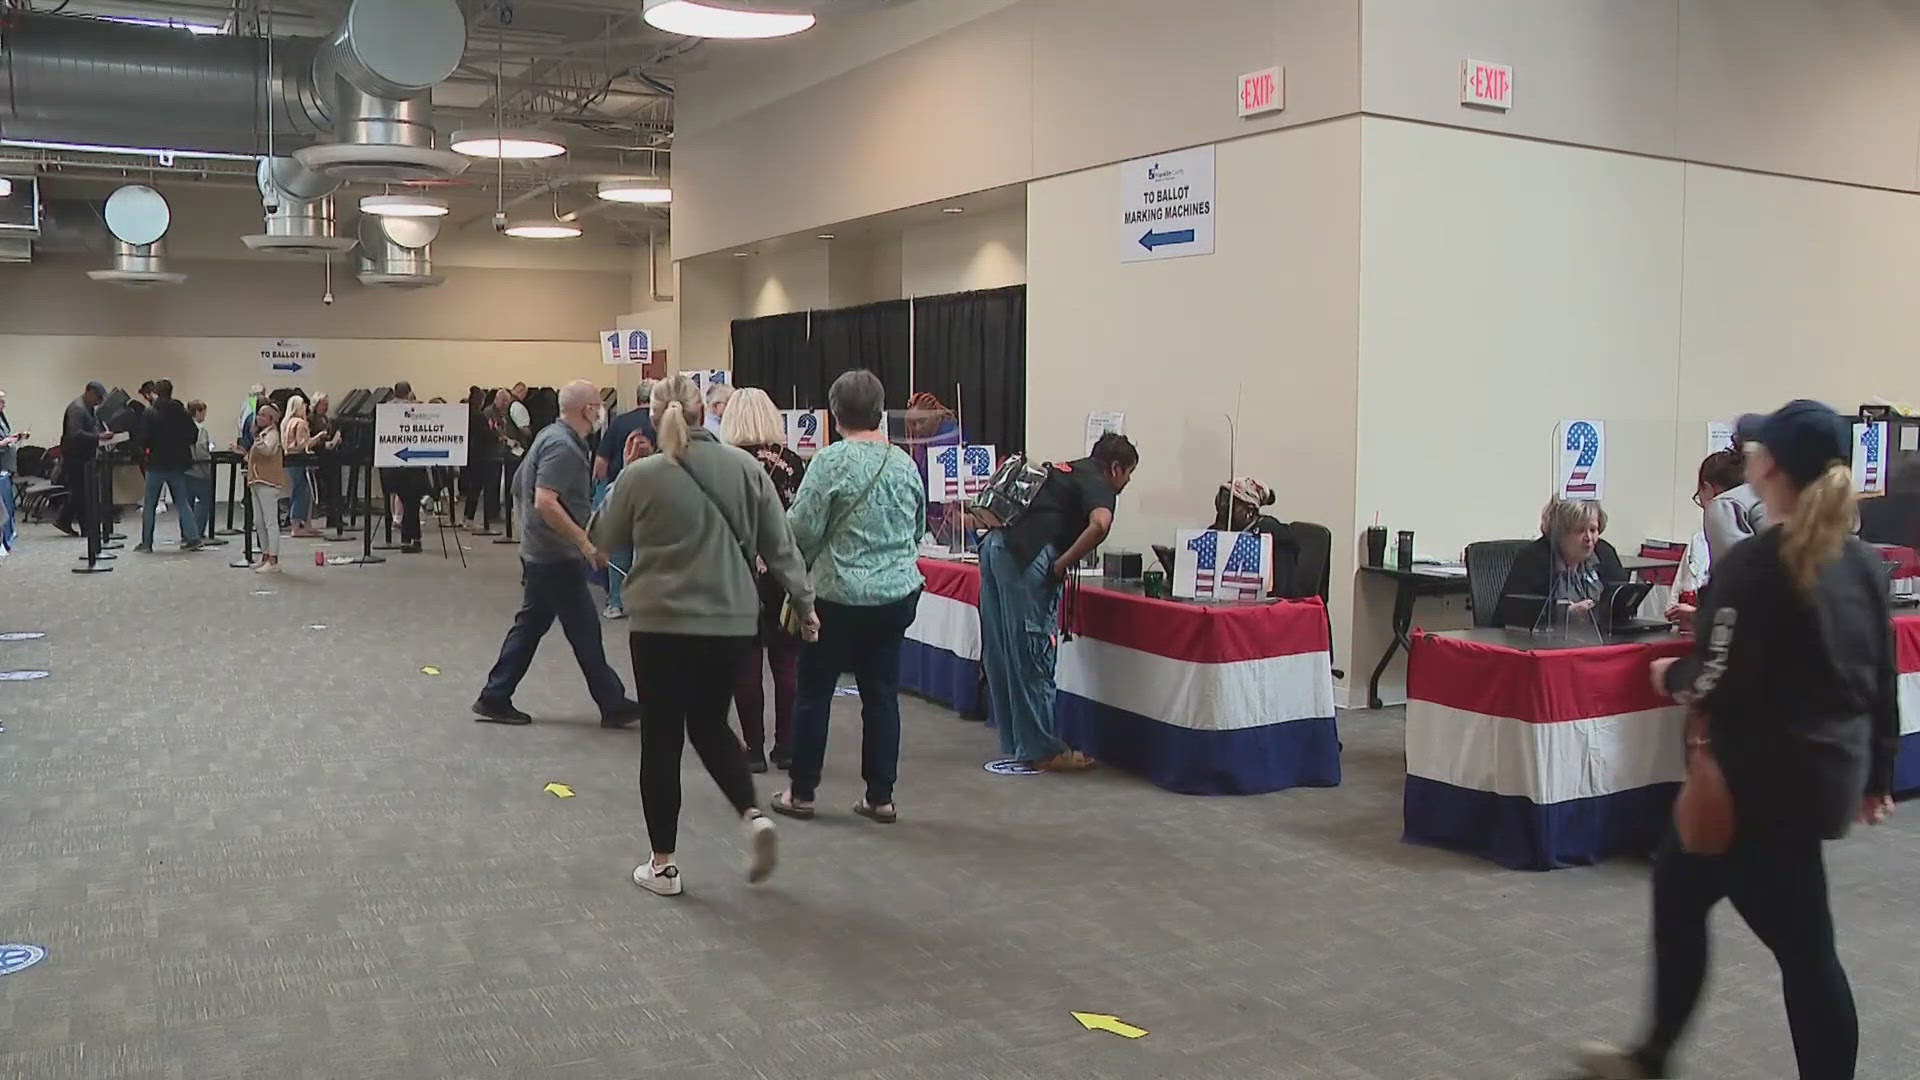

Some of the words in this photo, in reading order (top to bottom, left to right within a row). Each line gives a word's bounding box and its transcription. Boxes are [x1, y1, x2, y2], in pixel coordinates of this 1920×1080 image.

[1245, 74, 1272, 110] EXIT
[1475, 65, 1505, 101] EXIT
[1144, 191, 1155, 204] TO
[1157, 185, 1190, 202] BALLOT
[1124, 207, 1163, 224] MARKING
[1164, 201, 1210, 219] MACHINES
[607, 331, 649, 362] 10
[379, 435, 418, 444] MARKING
[420, 435, 464, 444] MACHINES
[399, 424, 410, 432] TO
[412, 424, 444, 432] BALLOT
[1565, 421, 1599, 499] 2
[1860, 423, 1880, 491] 1
[1187, 531, 1264, 600] 14
